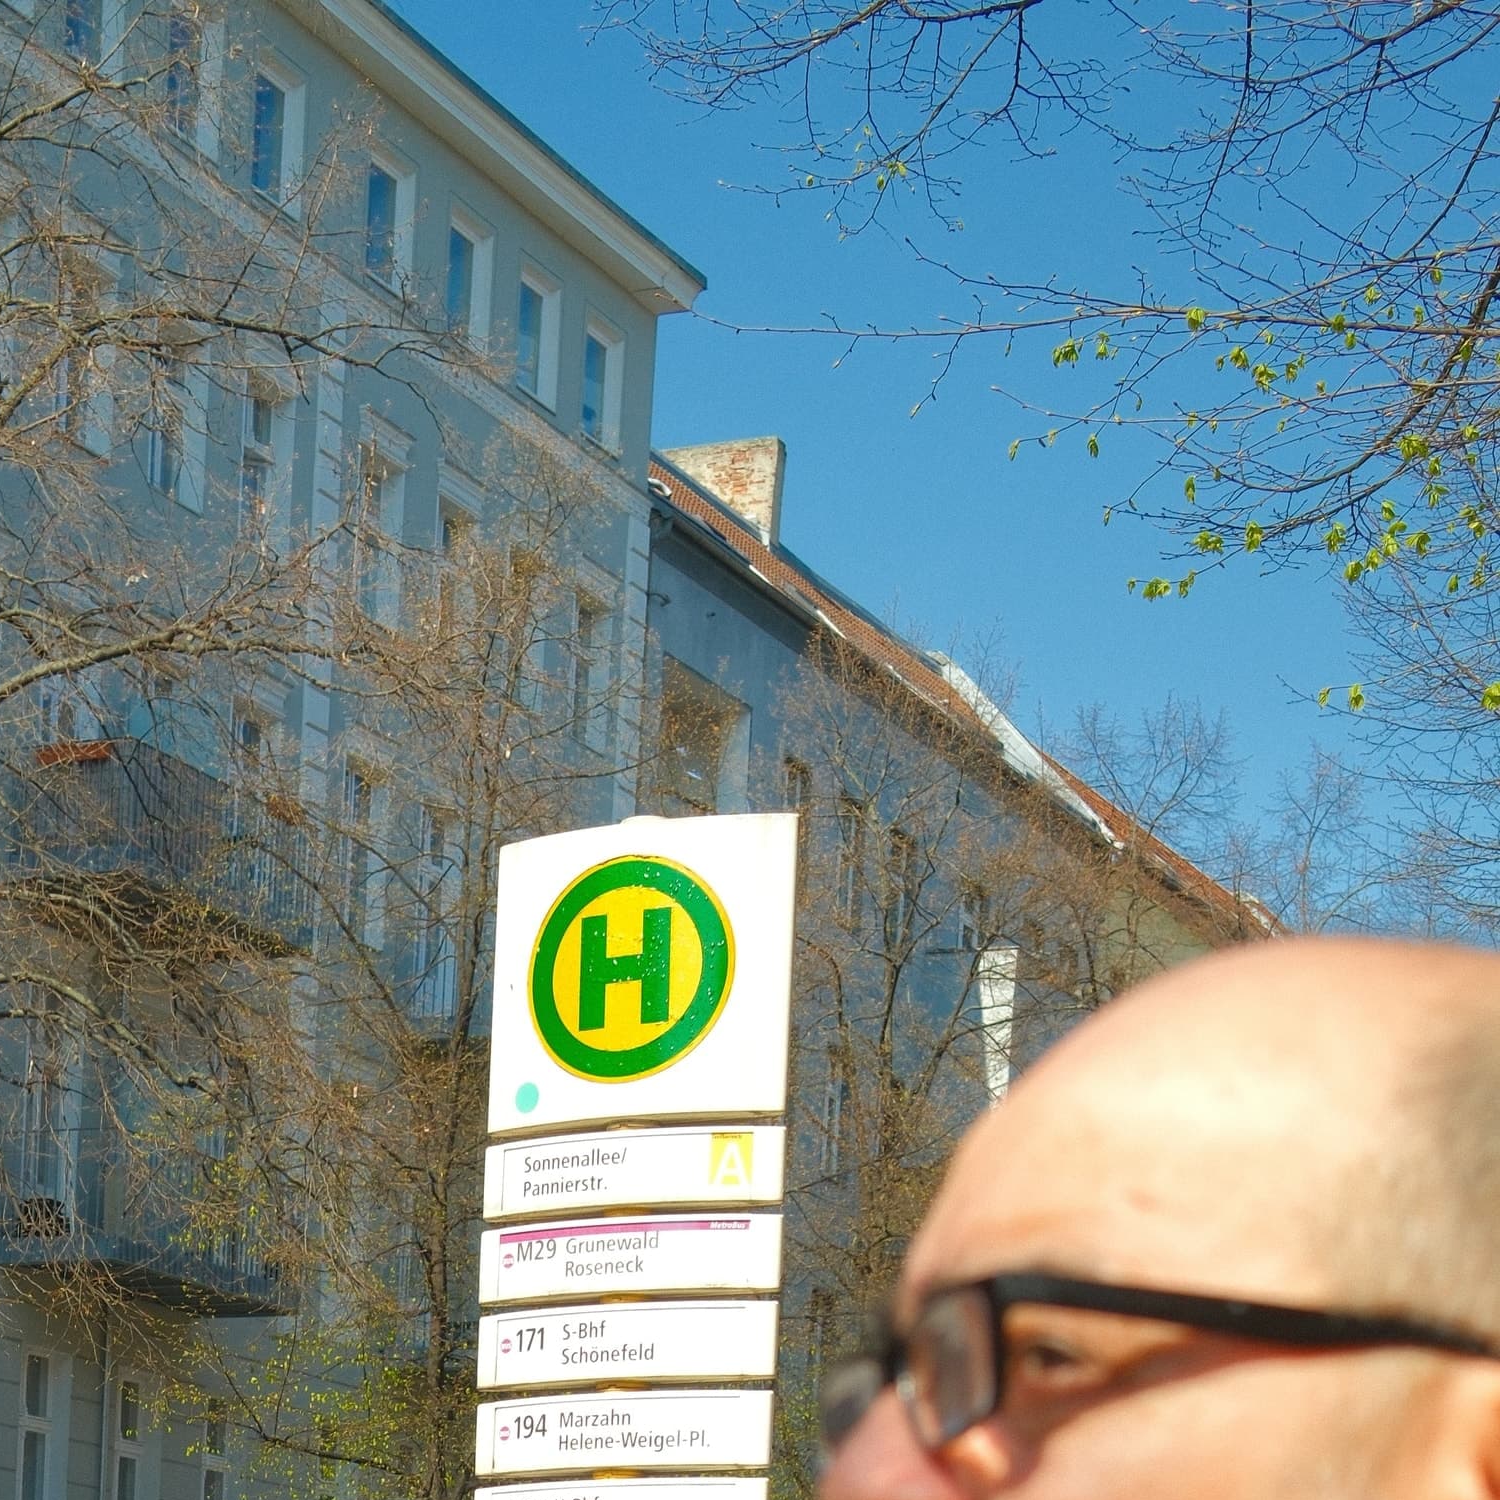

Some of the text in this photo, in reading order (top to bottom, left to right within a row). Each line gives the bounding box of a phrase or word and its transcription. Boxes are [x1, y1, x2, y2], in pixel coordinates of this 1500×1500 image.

[578, 906, 672, 1032] H
[523, 1147, 628, 1174] Sonnenallee/
[714, 1143, 749, 1185] A
[522, 1175, 609, 1198] Pannierstr.
[516, 1231, 660, 1263] M29 Grunewald
[564, 1256, 644, 1278] Roseneck
[515, 1327, 546, 1353] 171
[562, 1320, 607, 1341] S-Bhf
[561, 1343, 655, 1365] Schönefeld
[513, 1409, 631, 1440] 194 Marzahn
[558, 1430, 711, 1453] Helene-Weigel-Pl.
